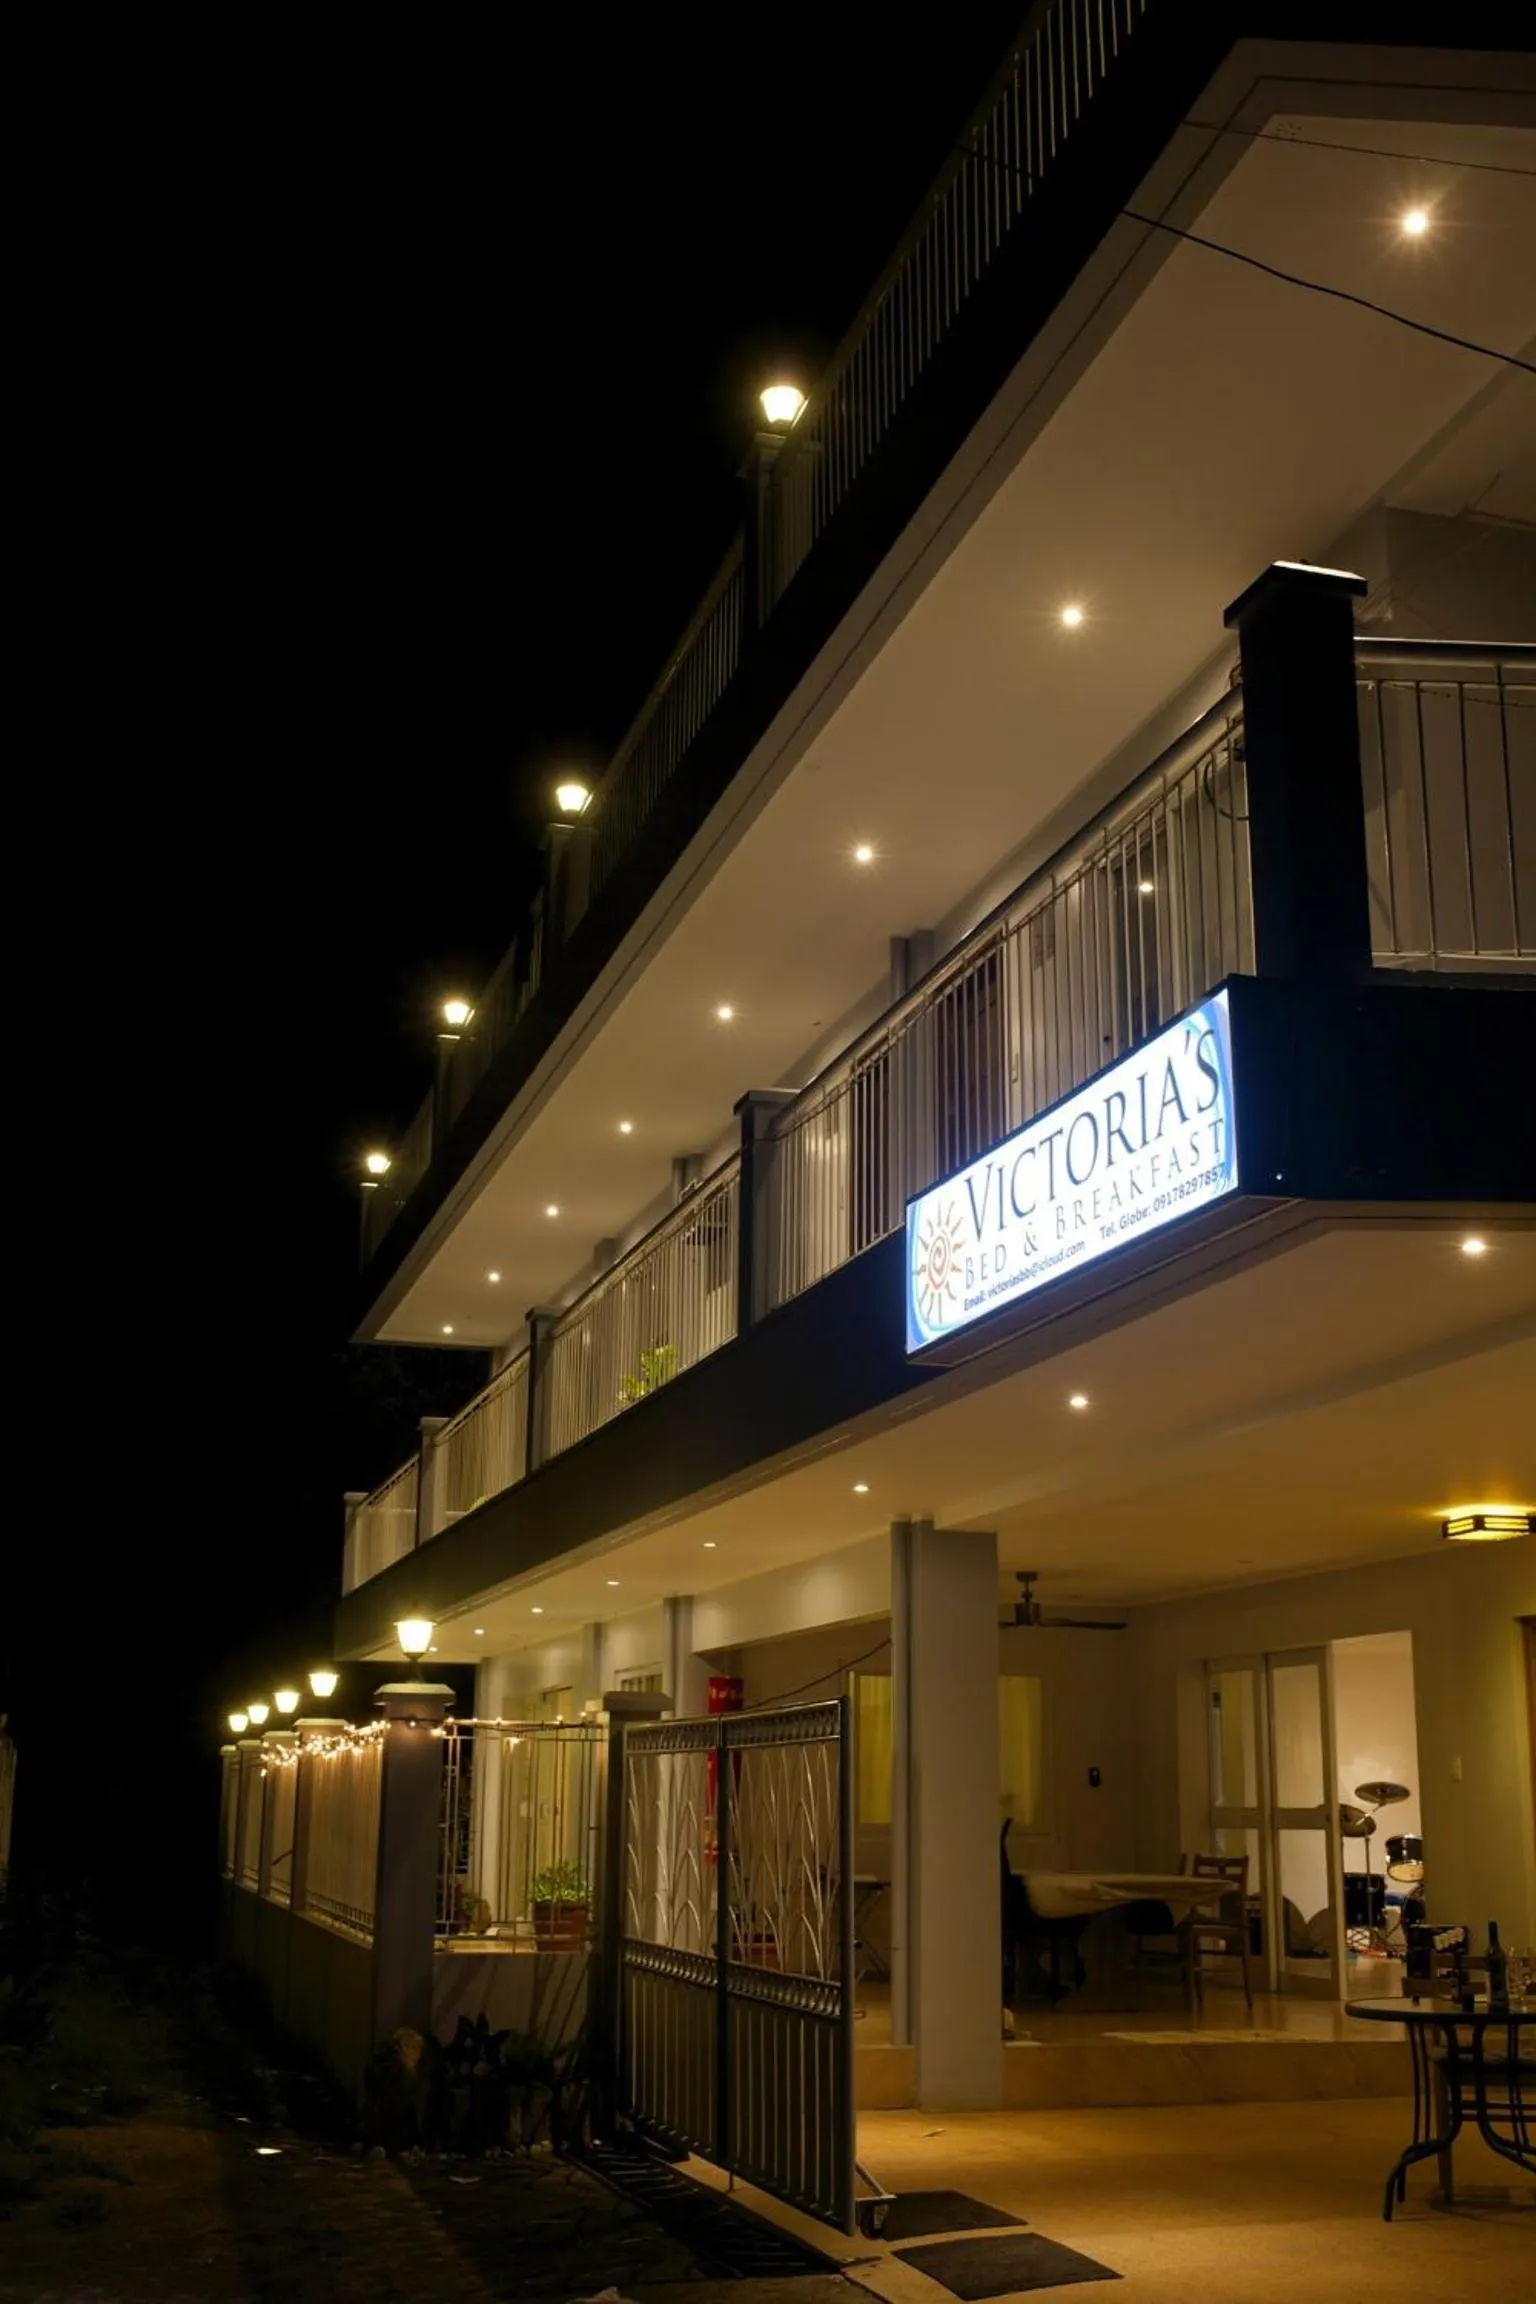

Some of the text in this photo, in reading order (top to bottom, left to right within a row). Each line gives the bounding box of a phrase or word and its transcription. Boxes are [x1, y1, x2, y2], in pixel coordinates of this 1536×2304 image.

[964, 1029, 1219, 1242] VICTORIA'S
[965, 1118, 1225, 1290] BED & BREAKFAST
